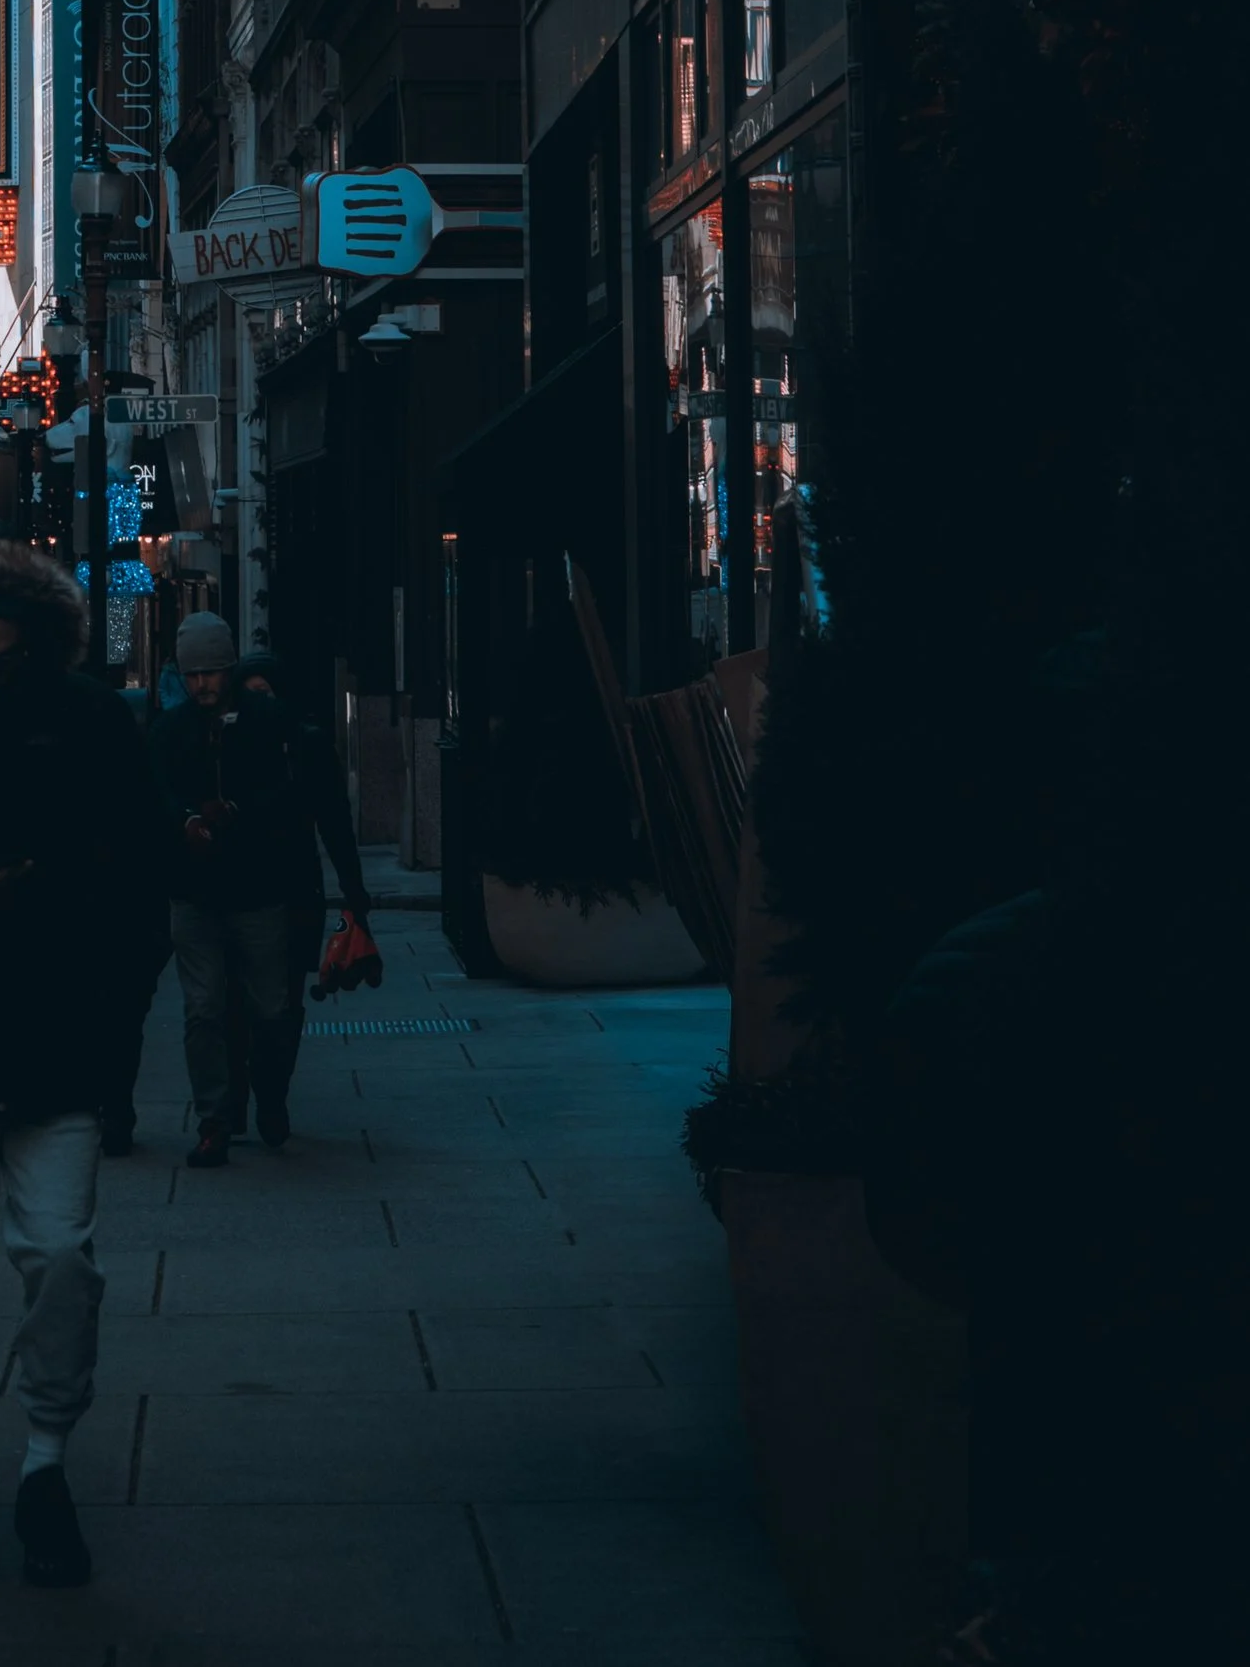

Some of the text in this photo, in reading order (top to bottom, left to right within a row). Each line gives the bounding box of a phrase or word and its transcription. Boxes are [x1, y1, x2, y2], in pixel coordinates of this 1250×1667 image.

[193, 231, 265, 276] BACK
[126, 399, 197, 421] WEST ST
